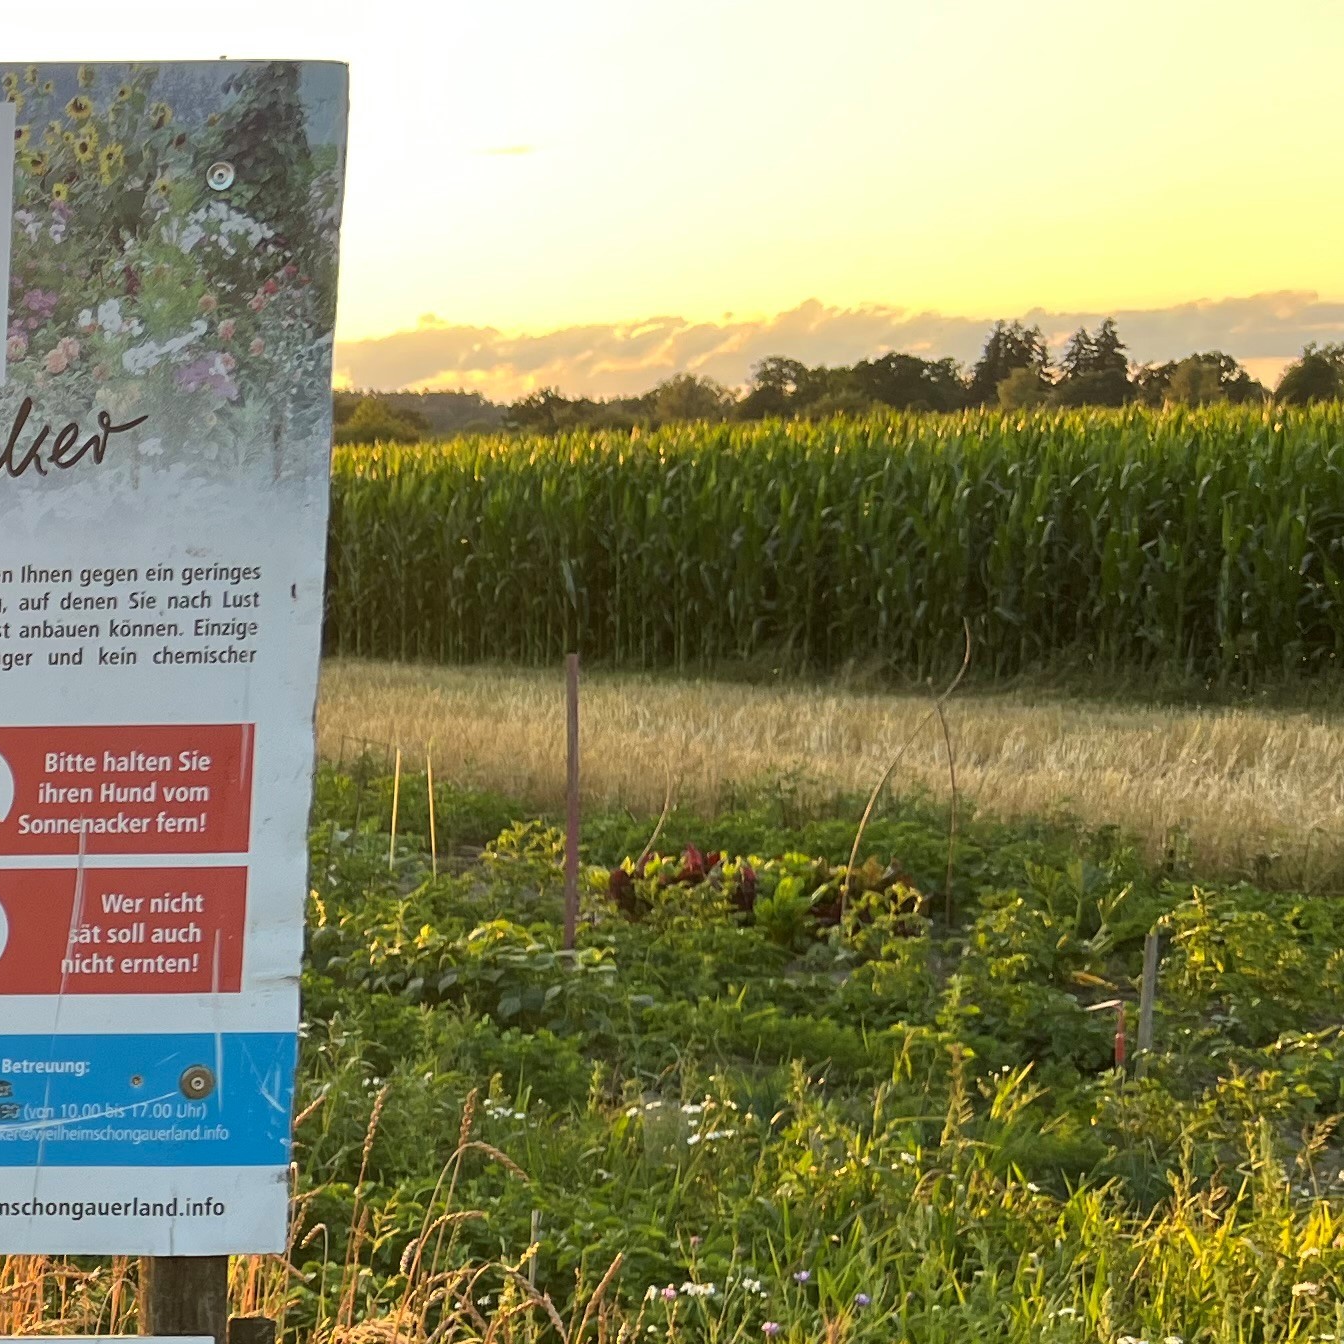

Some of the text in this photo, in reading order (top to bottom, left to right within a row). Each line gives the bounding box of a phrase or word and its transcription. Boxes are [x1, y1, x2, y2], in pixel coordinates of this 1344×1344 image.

[20, 563, 73, 584] Ihnen
[79, 568, 139, 588] gegen
[145, 562, 174, 582] ein
[181, 562, 262, 586] geringes
[18, 591, 51, 612] auf
[59, 591, 118, 611] denen
[128, 590, 159, 611] Sie
[167, 590, 212, 610] nach
[222, 590, 260, 609] Lust
[18, 619, 100, 639] anbauen
[108, 618, 185, 638] können.
[193, 617, 258, 641] Einzige
[47, 646, 84, 666] und
[98, 646, 137, 666] kein
[152, 644, 258, 665] chemischer
[44, 749, 212, 773] Bitte halten Sie
[38, 781, 210, 804] ihren Hund vom
[17, 811, 207, 835] Sonnenacker fern!
[101, 891, 205, 914] Wer nicht
[68, 922, 202, 945] sät soll auch
[60, 953, 199, 975] nicht ernten!
[1, 1058, 91, 1077] Betreuung:
[60, 1103, 101, 1120] 10.00
[132, 1102, 173, 1120] 17.00
[176, 1102, 208, 1121] Uhr)
